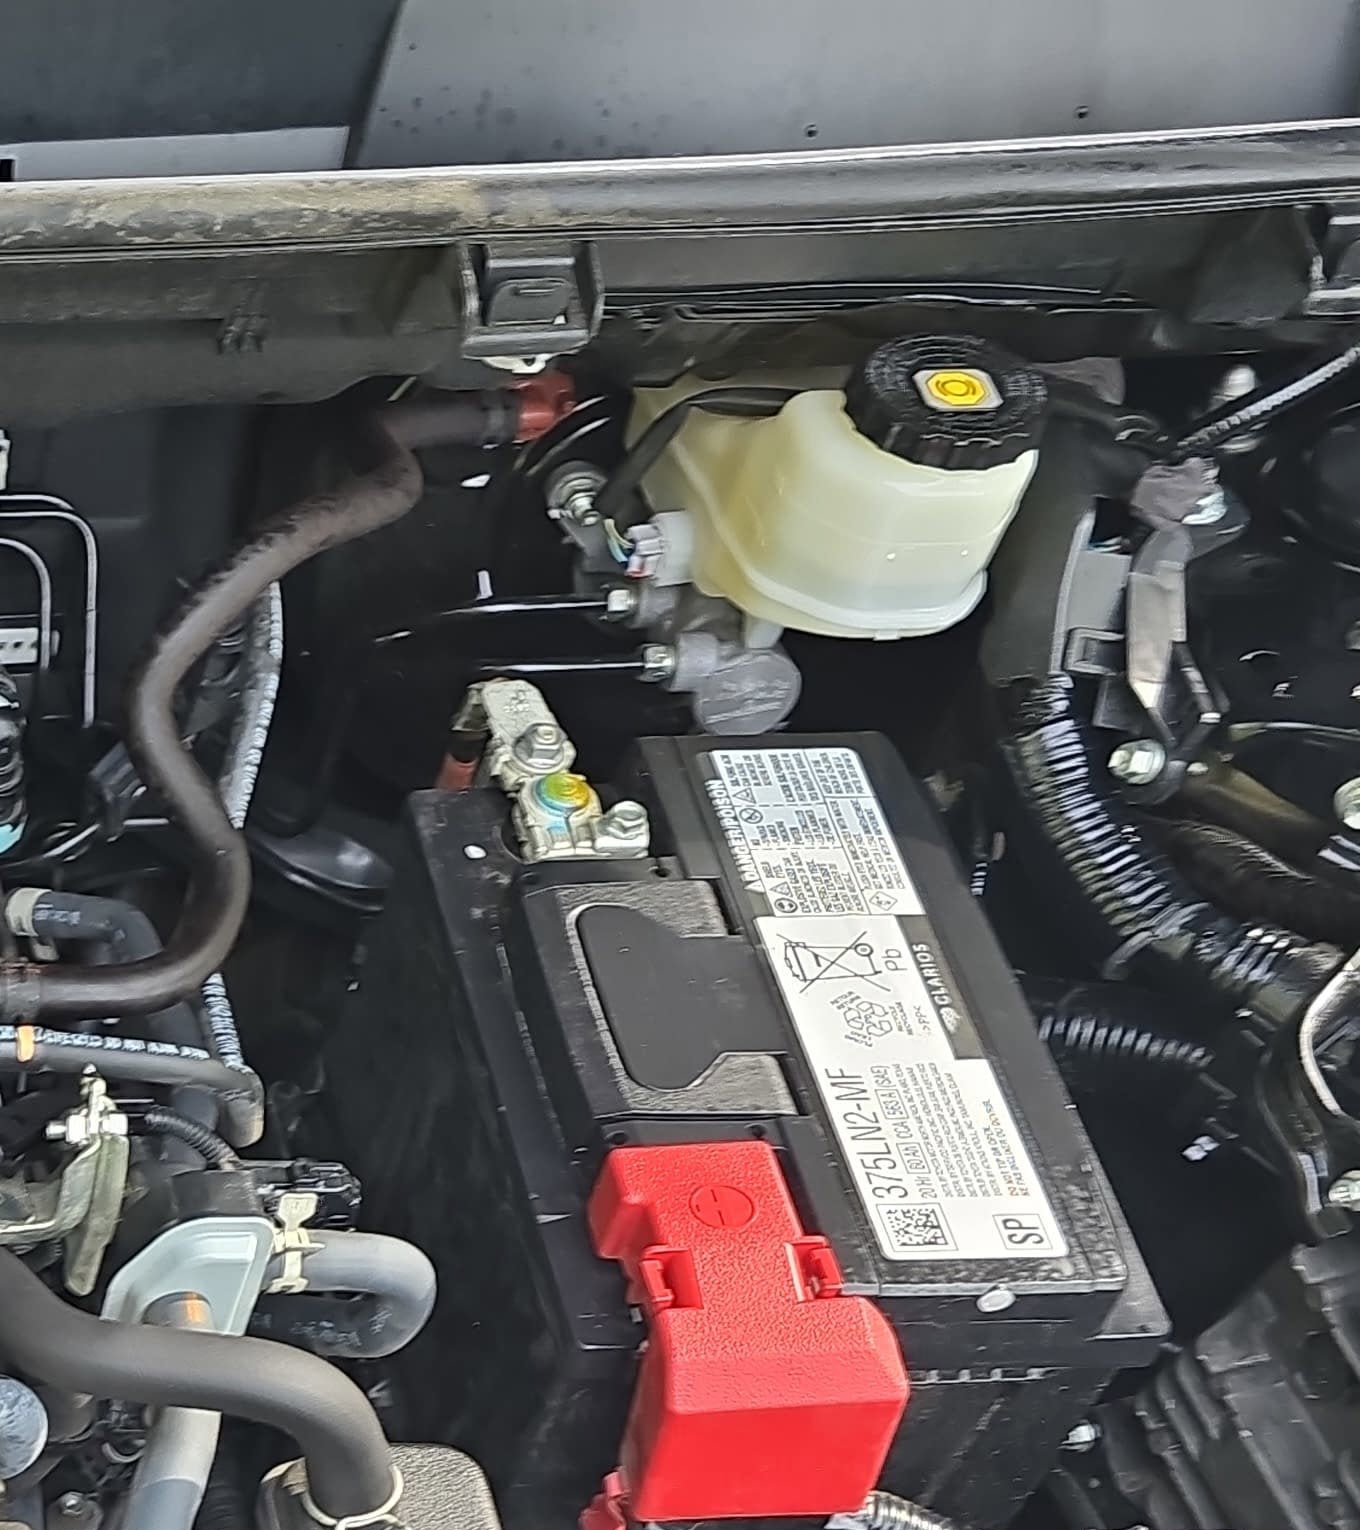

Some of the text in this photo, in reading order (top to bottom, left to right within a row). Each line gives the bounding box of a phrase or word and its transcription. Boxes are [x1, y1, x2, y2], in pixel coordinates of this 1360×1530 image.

[703, 778, 761, 882] DANGER/POISON
[879, 948, 908, 971] Pb
[910, 943, 955, 1006] CLARIOS
[868, 1064, 897, 1088] (SAE)
[822, 1066, 911, 1200] 375LN2-MF
[890, 1120, 914, 1139] CCA
[917, 1186, 938, 1198] 20
[998, 1217, 1046, 1245] SP
